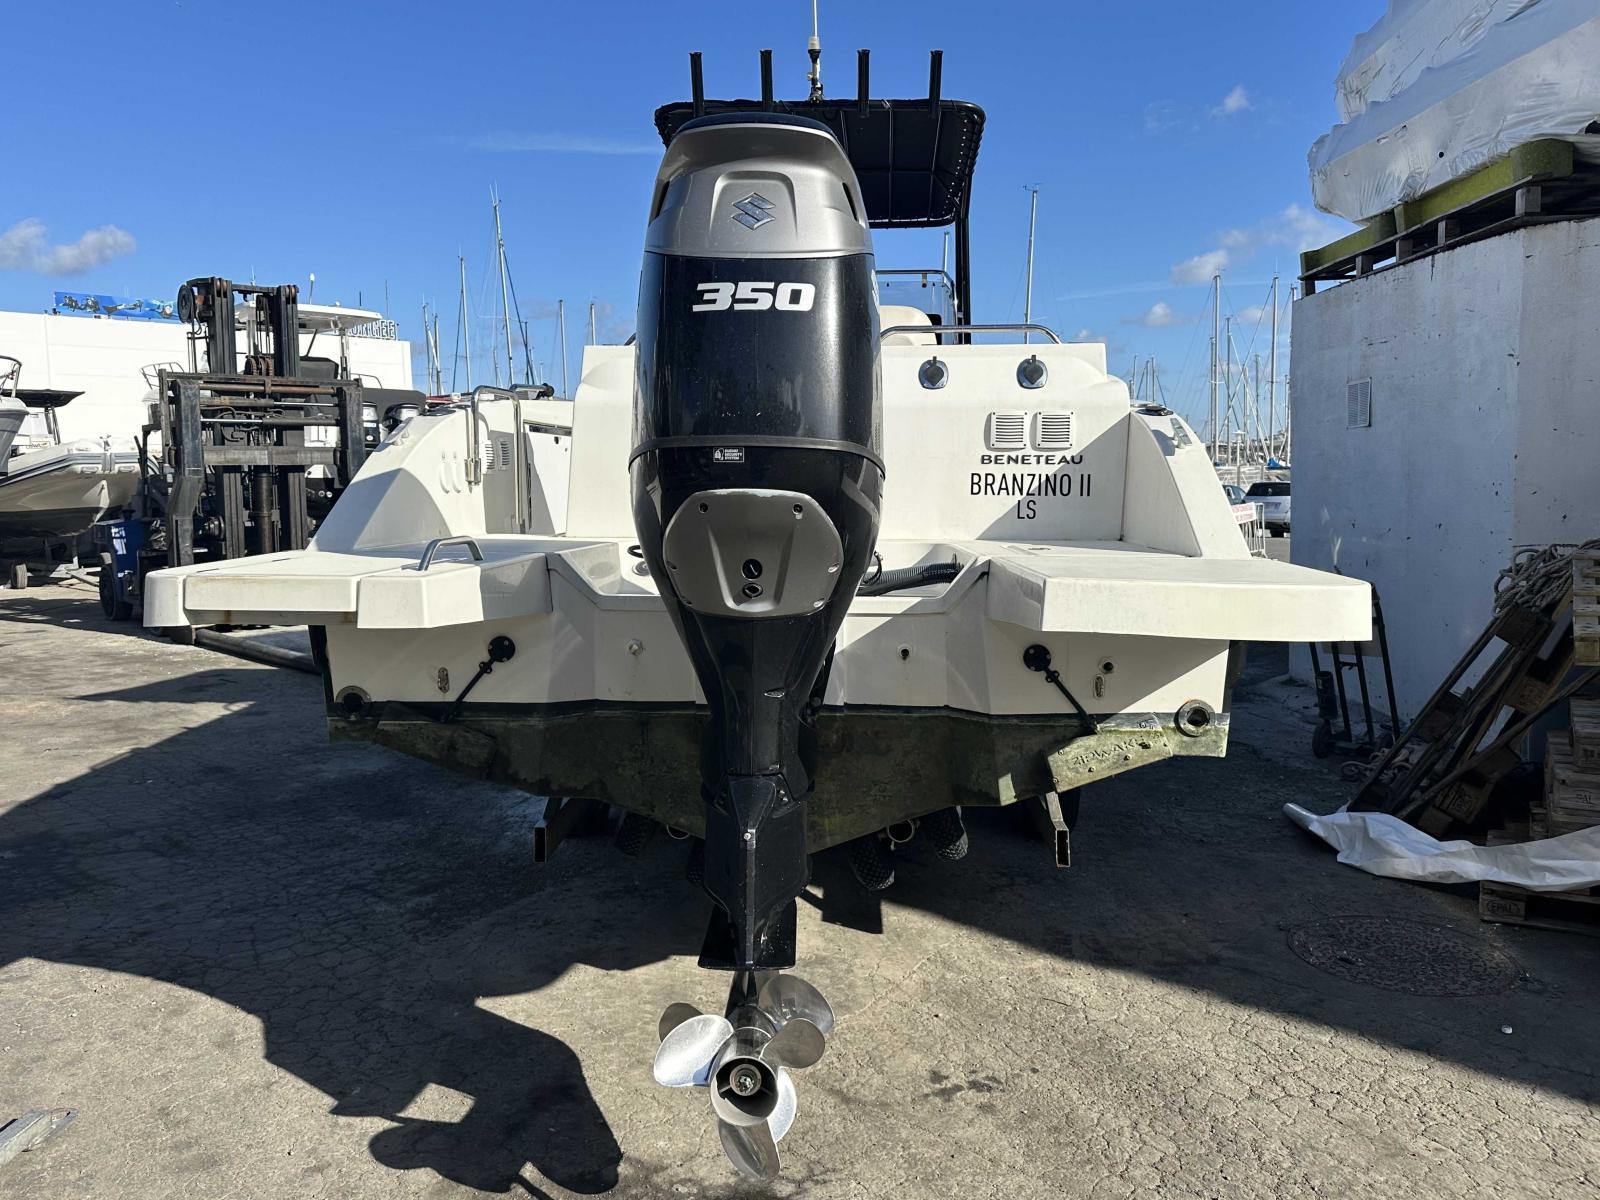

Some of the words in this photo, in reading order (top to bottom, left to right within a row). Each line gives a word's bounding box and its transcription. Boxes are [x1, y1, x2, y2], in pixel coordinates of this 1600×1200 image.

[692, 281, 816, 312] 350
[980, 454, 1084, 466] BENETEAU
[970, 472, 1072, 497] BRANZINO
[1079, 473, 1091, 497] II
[1016, 499, 1037, 520] LS
